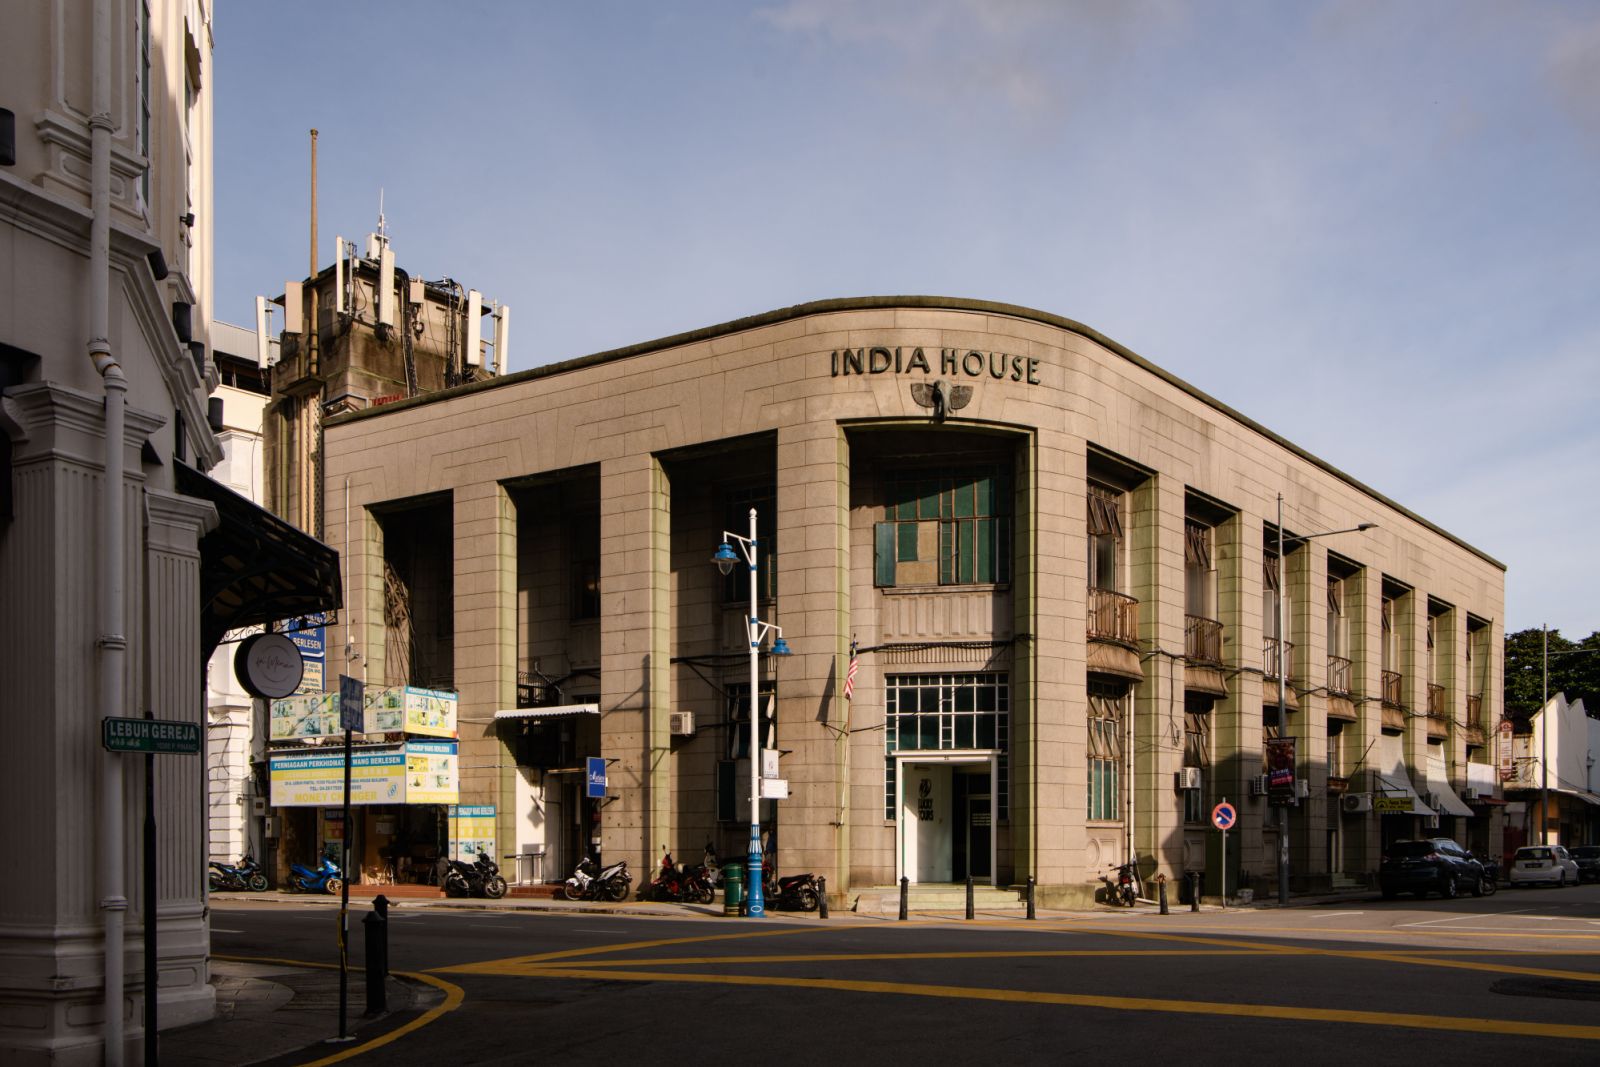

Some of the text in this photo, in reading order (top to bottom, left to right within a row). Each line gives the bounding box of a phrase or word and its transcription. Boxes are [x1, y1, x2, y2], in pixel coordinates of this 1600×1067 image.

[831, 346, 1041, 385] INDIA HOUSE
[292, 637, 322, 649] BERLESEN
[110, 722, 196, 741] LEBUH GEREJA
[274, 761, 308, 769] PERNIAGAAN
[353, 757, 369, 766] WANG
[370, 756, 401, 765] BERLESEN
[294, 791, 328, 802] MONEY
[330, 790, 377, 802] CHNGER
[918, 809, 934, 821] TOURS
